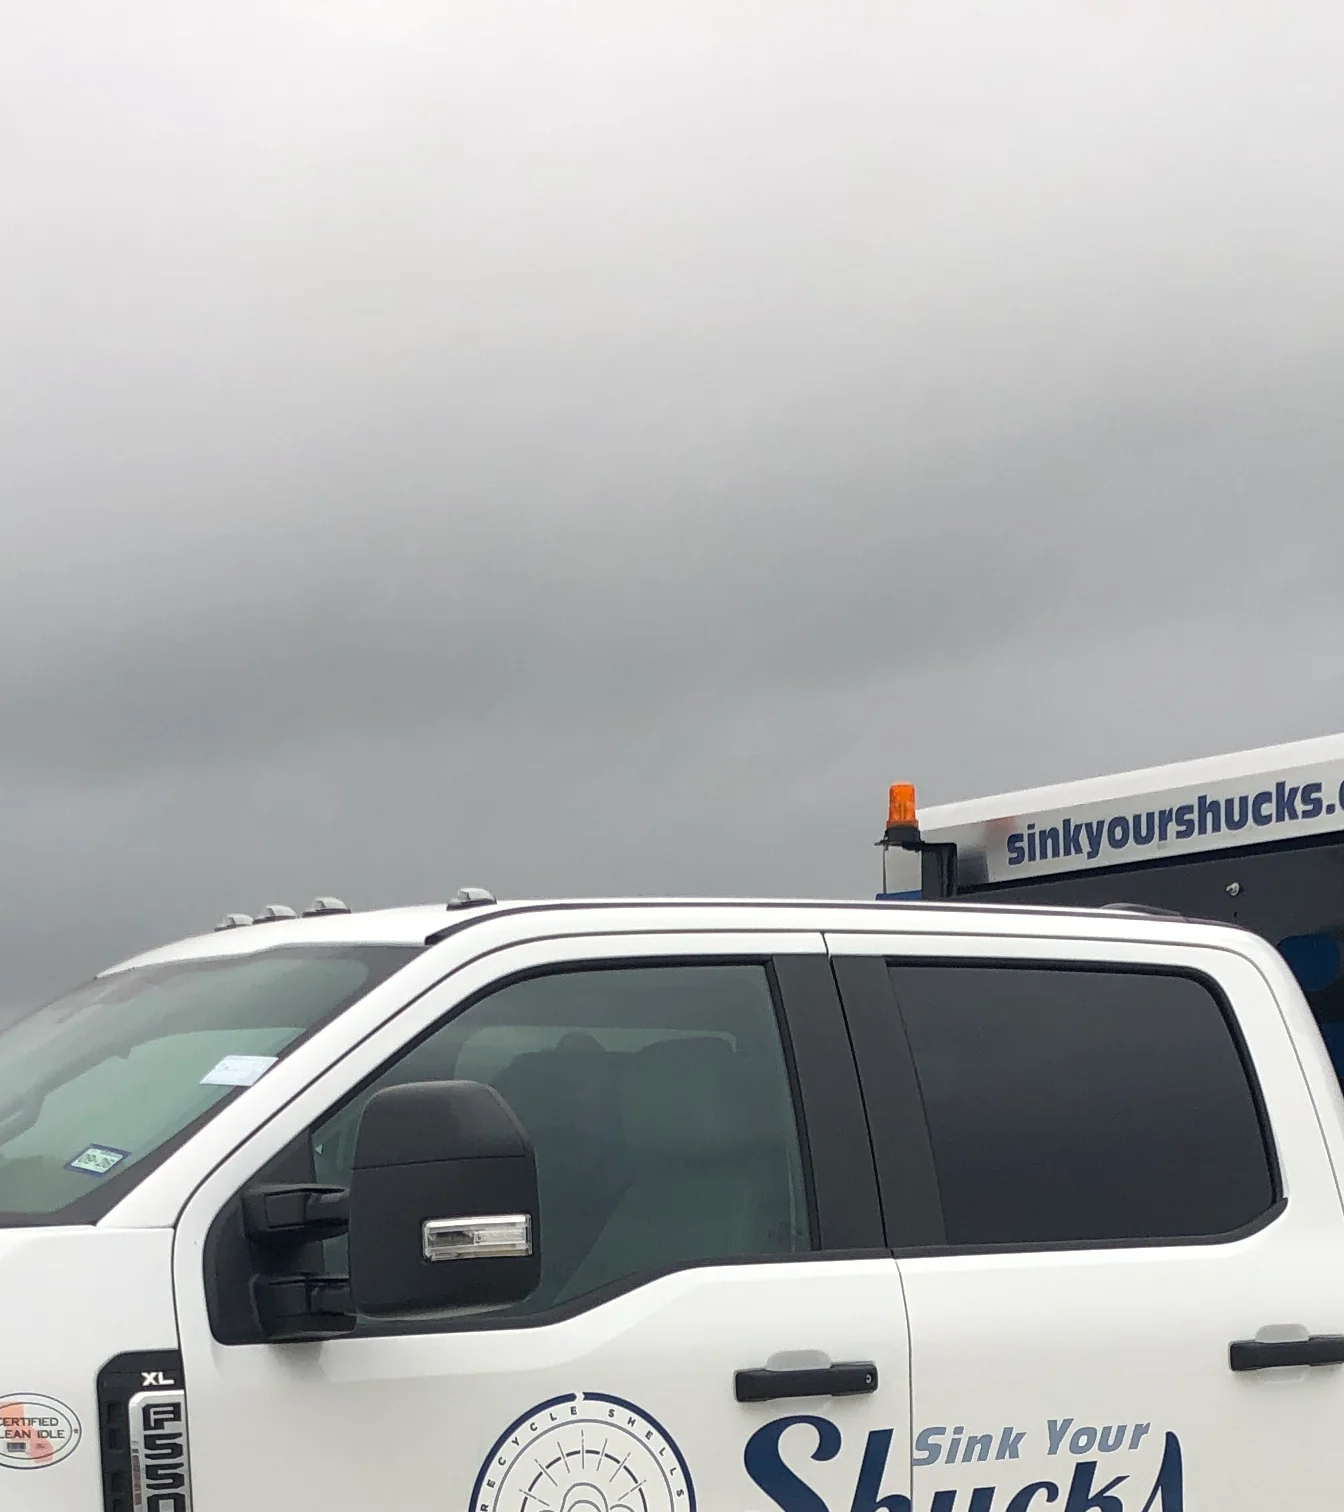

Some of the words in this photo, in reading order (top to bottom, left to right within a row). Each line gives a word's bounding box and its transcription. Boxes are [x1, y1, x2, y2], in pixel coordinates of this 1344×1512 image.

[141, 1371, 175, 1386] XL
[37, 1429, 66, 1439] IDLE
[912, 1426, 1028, 1466] Sink
[1046, 1418, 1152, 1457] Your
[480, 1405, 578, 1512] RECYCLE
[607, 1408, 685, 1498] SHELLS
